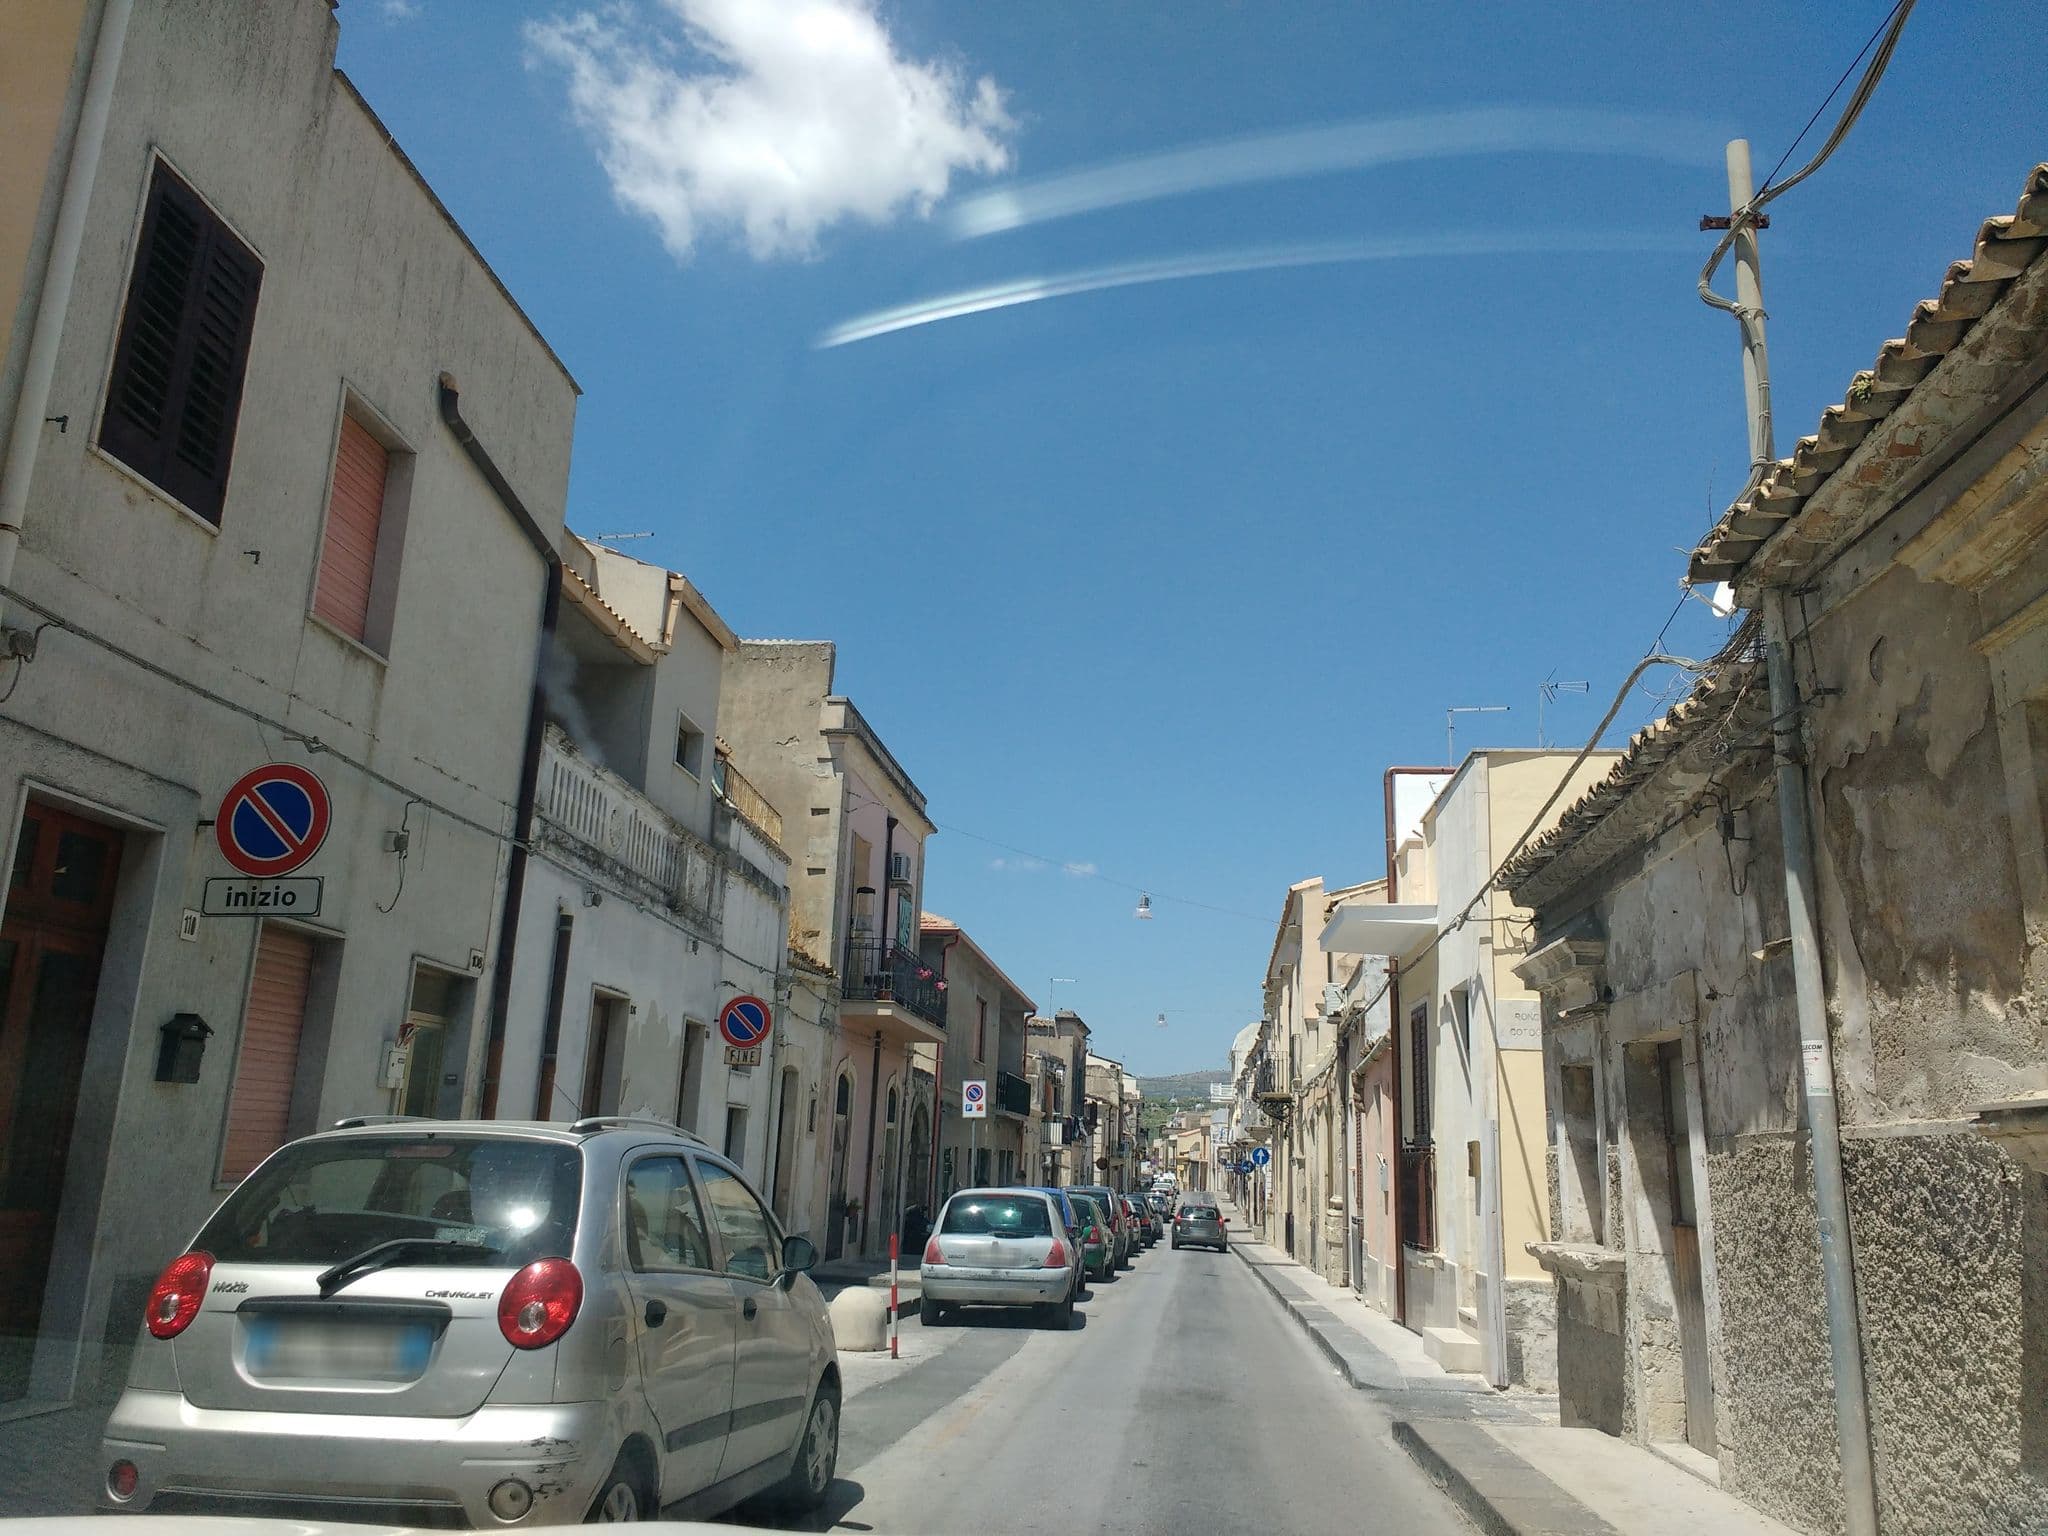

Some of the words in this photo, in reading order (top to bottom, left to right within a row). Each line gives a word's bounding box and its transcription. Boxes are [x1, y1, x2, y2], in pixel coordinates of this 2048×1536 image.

[225, 885, 297, 907] inizio
[730, 1049, 756, 1063] FINE
[425, 1289, 494, 1300] CHEVROLET
